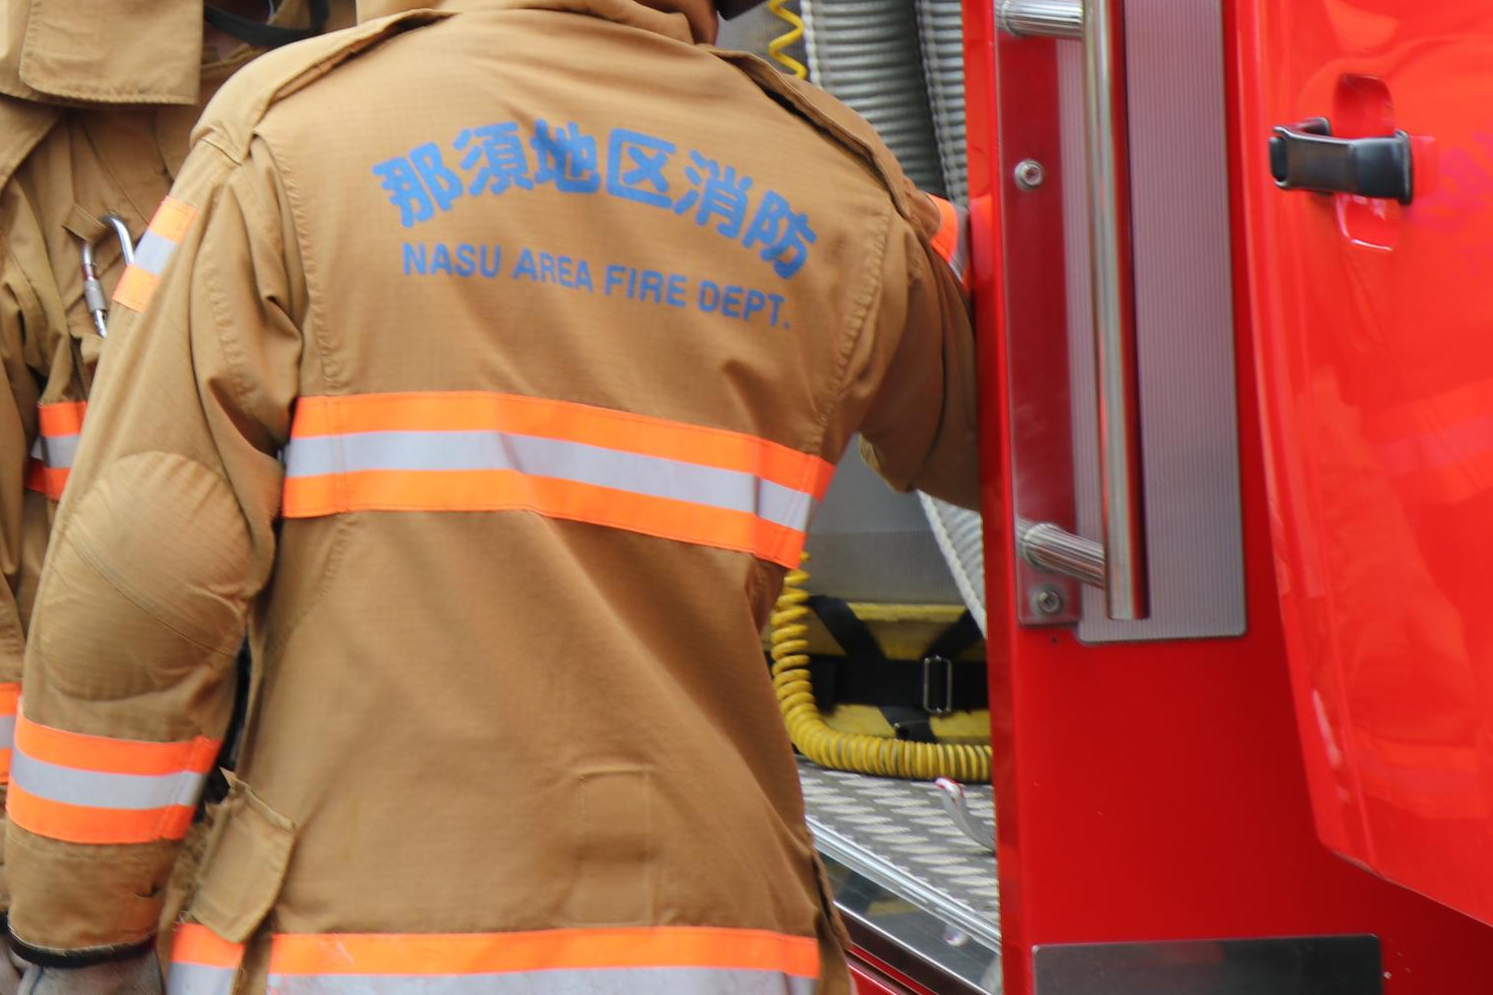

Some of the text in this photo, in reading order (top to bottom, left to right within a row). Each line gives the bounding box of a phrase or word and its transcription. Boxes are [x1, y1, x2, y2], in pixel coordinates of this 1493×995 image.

[372, 118, 817, 280] 那須地区消防
[403, 243, 792, 330] NASU AREA FIRE DEPT.
